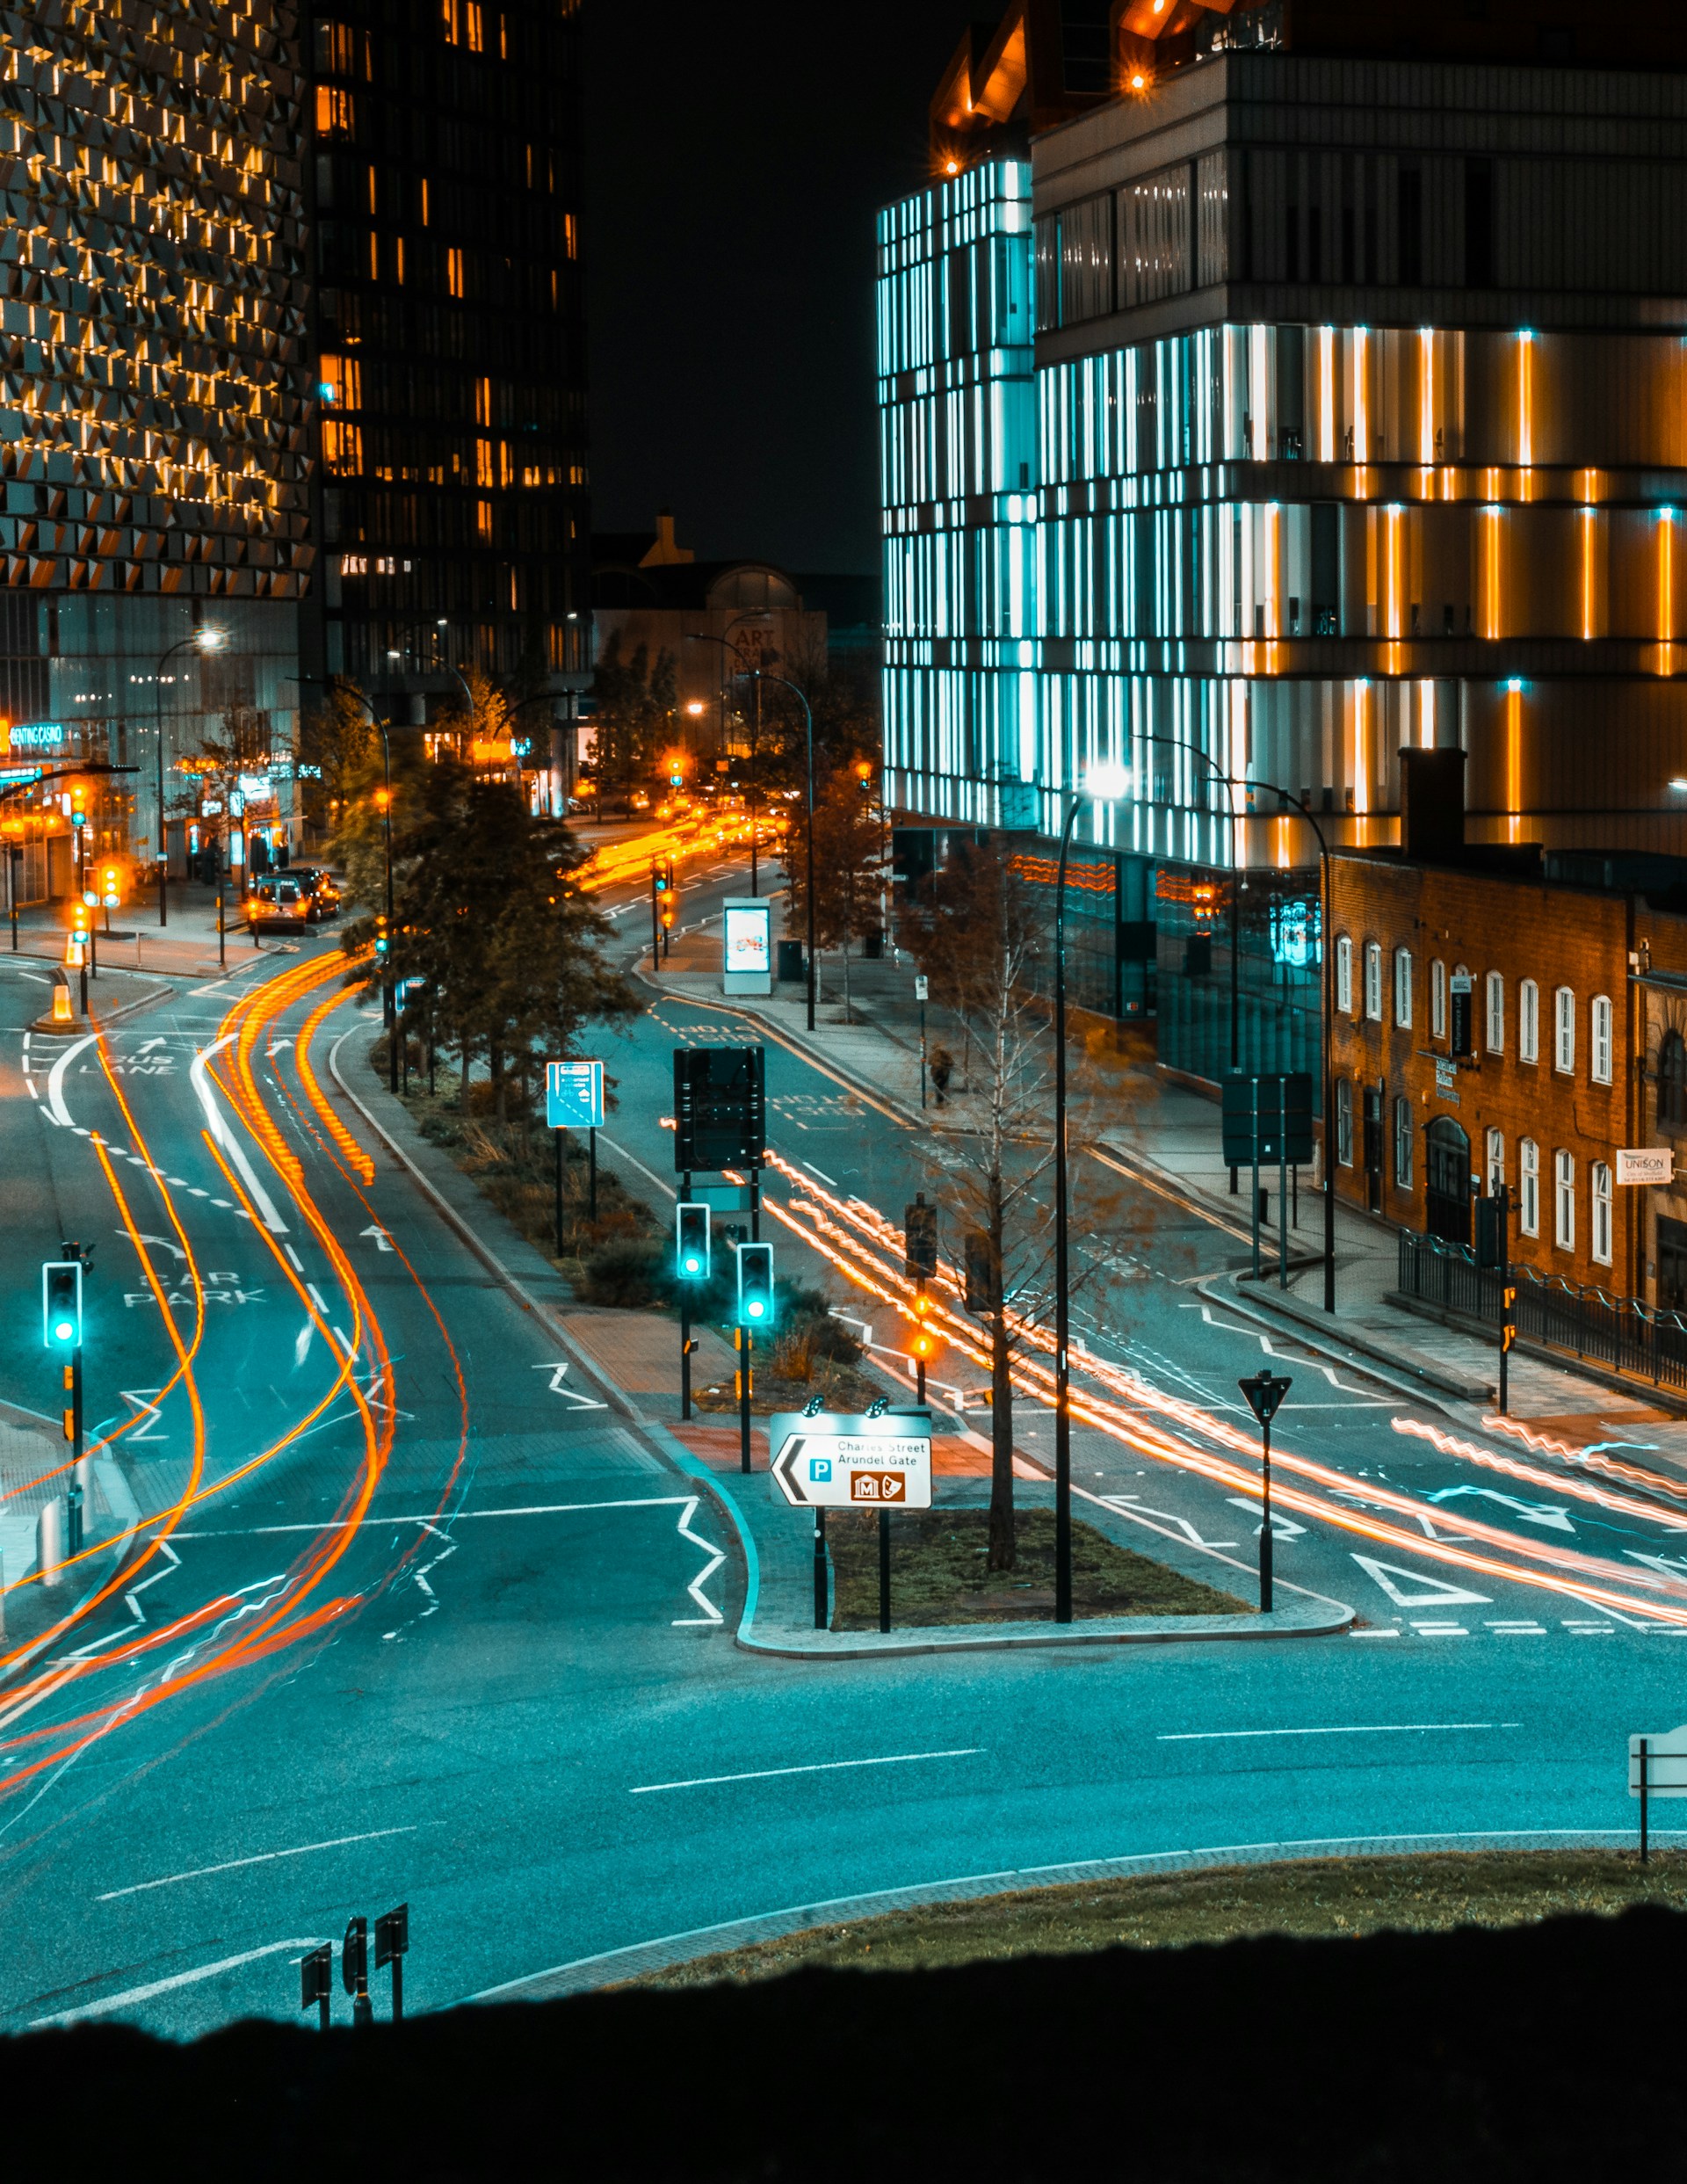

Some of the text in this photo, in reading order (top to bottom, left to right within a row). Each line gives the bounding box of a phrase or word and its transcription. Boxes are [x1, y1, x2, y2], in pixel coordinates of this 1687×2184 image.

[735, 629, 775, 647] ART
[38, 725, 62, 744] CASINO
[105, 1055, 176, 1064] BUS
[78, 1064, 180, 1075] LANE
[1625, 1157, 1664, 1169] UNISON
[139, 1272, 242, 1287] CAR
[123, 1288, 267, 1308] PARK
[837, 1441, 925, 1454] Charles Street
[838, 1455, 917, 1466] Arundel Gate
